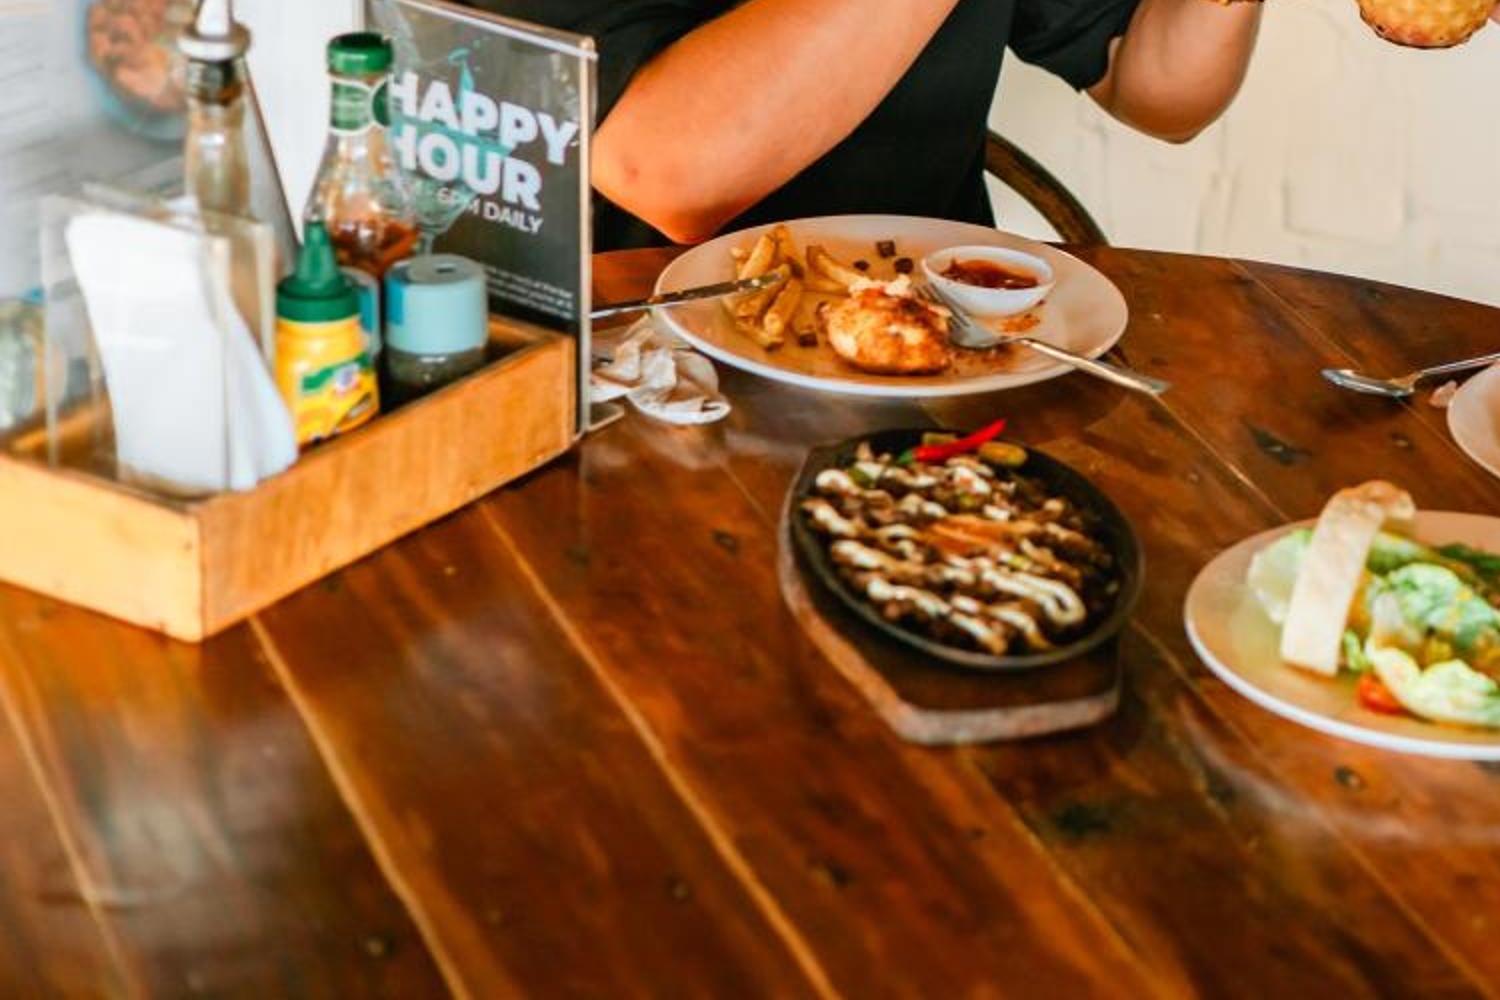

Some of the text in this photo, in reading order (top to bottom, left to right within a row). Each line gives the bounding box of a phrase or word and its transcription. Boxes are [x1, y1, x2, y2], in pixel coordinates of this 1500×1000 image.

[387, 71, 579, 165] HAPPY
[392, 124, 542, 211] HOUR
[482, 200, 544, 234] DAILY
